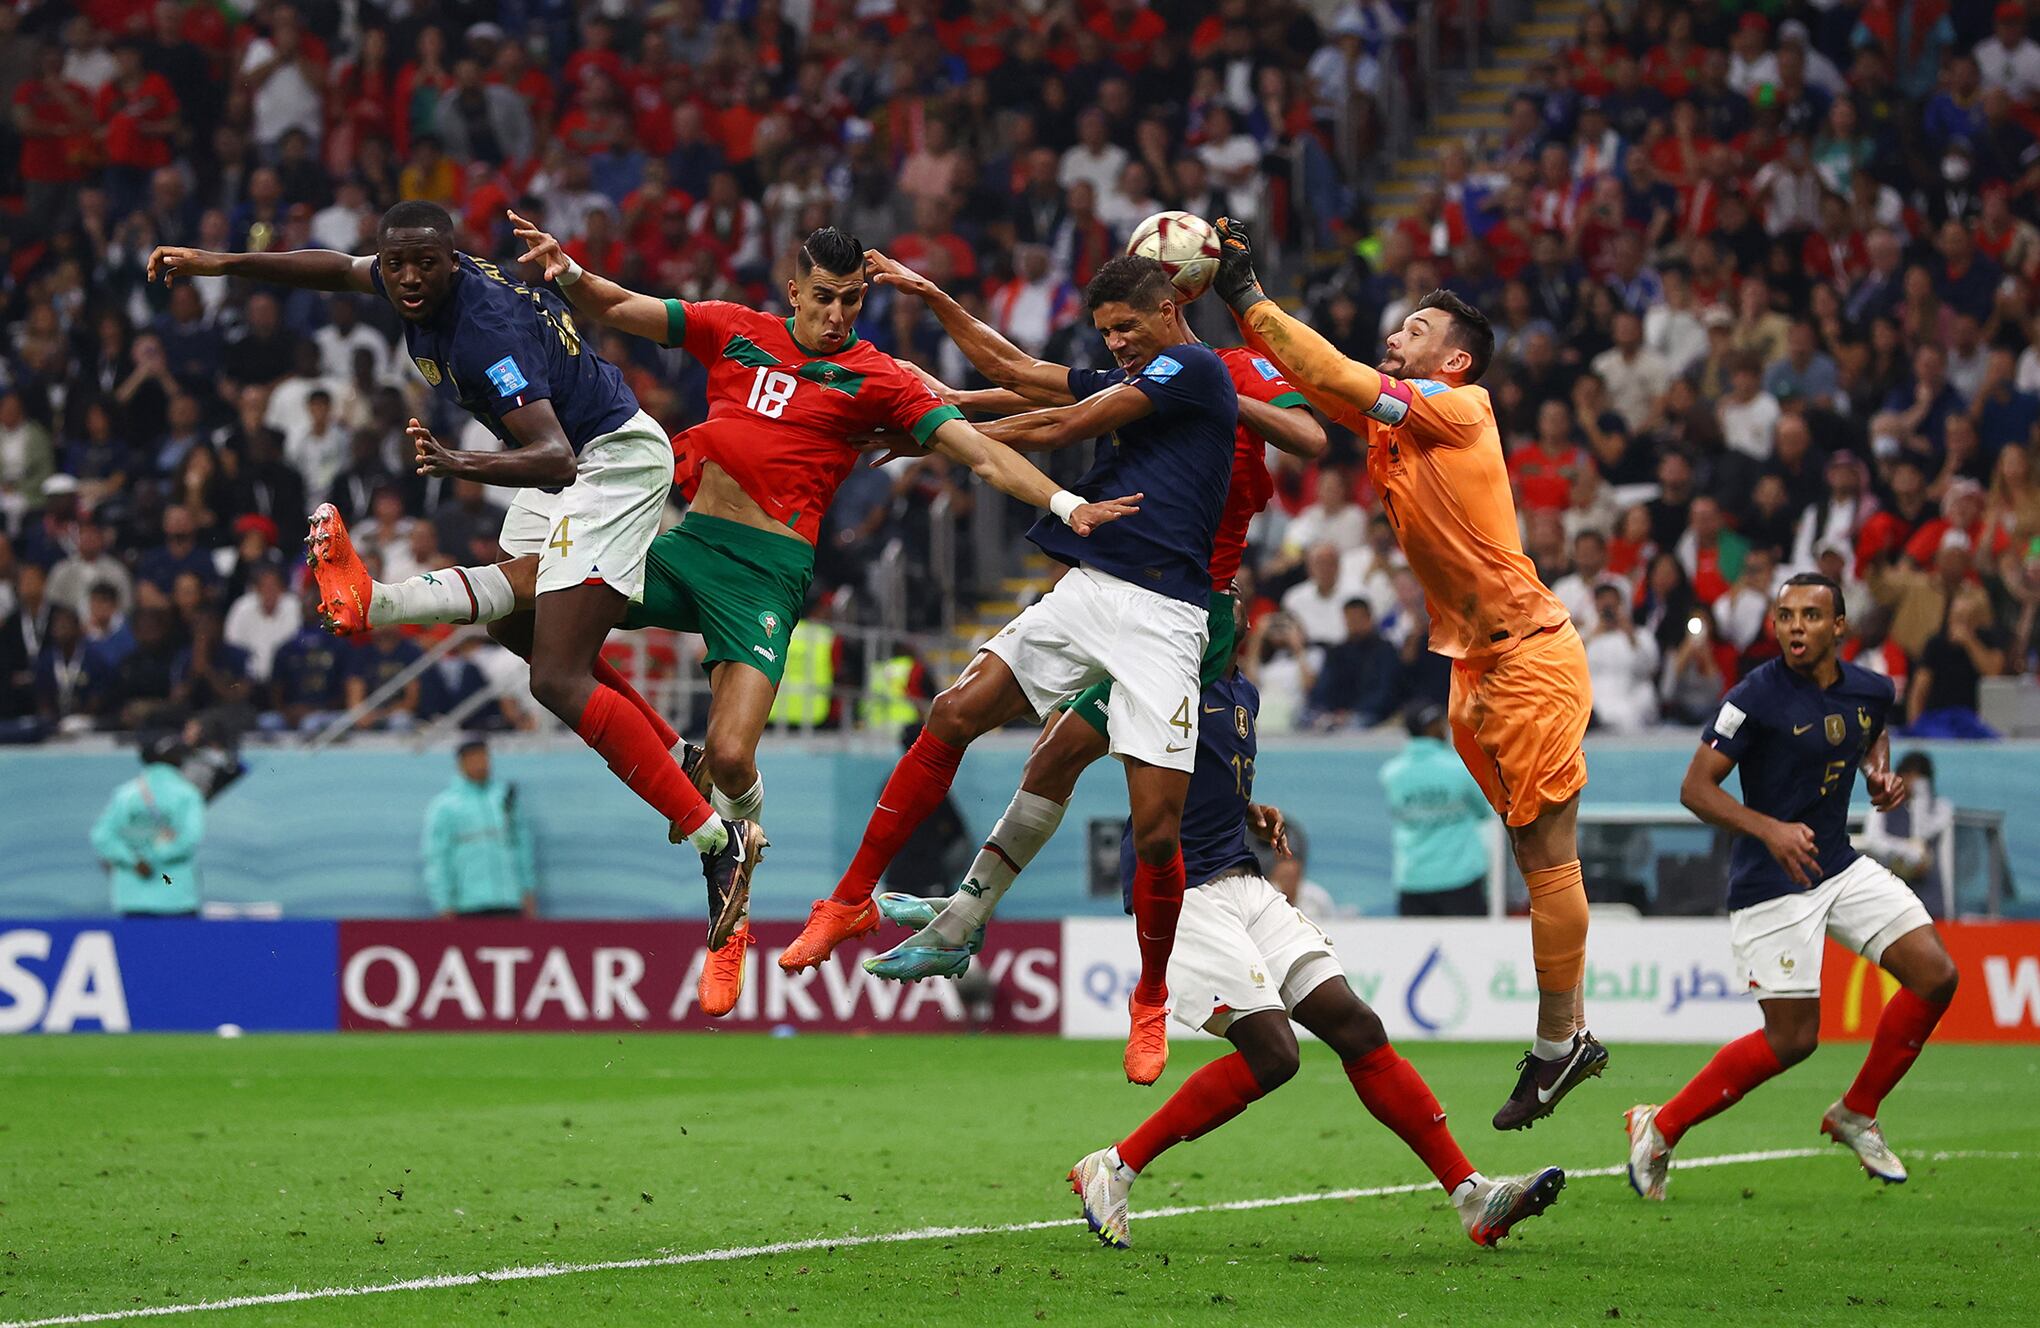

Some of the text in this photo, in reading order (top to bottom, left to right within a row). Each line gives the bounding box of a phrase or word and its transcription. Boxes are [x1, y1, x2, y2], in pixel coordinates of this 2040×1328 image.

[746, 365, 798, 419] 18
[548, 515, 573, 558] 4
[1169, 695, 1193, 739] 4
[1231, 753, 1254, 801] 13
[1820, 759, 1846, 797] 5
[0, 928, 133, 1034] SA
[342, 945, 649, 1028] QATAR
